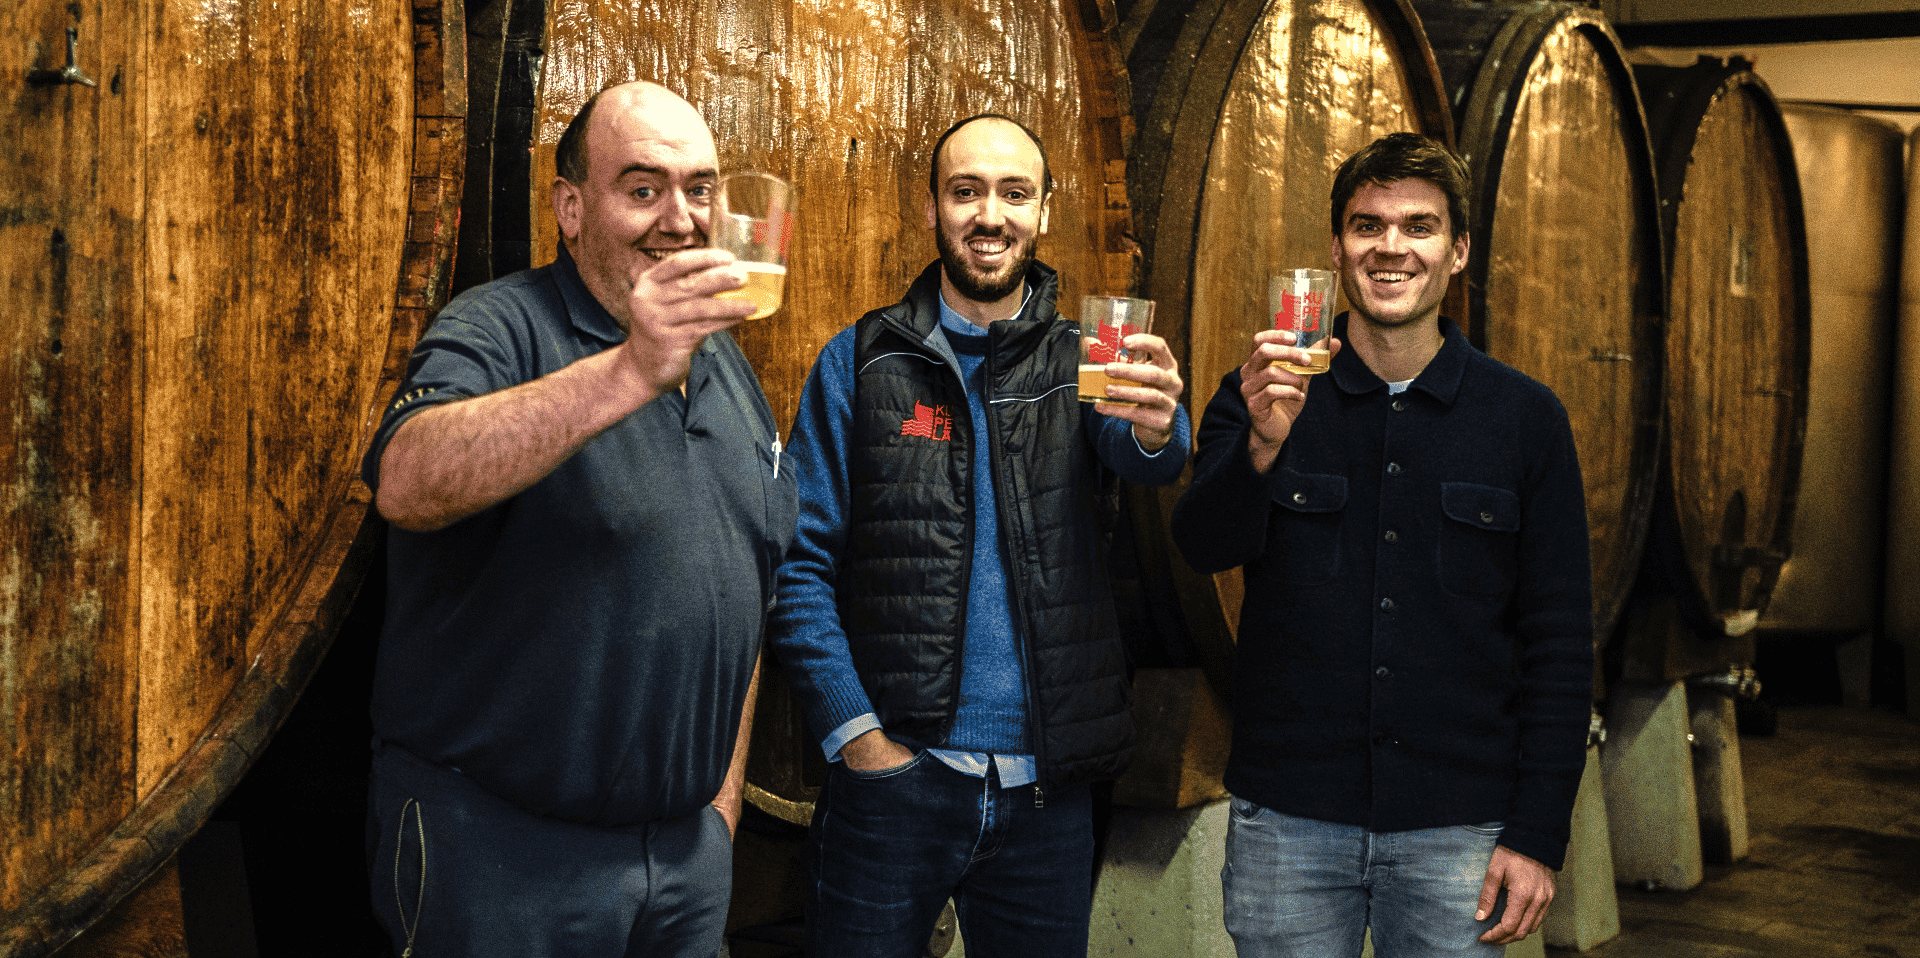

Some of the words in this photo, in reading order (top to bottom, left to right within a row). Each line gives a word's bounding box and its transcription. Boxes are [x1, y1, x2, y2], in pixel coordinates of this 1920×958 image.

[1303, 291, 1322, 304] KU
[1303, 306, 1321, 318] PE
[933, 416, 953, 430] PE
[931, 429, 952, 441] LA
